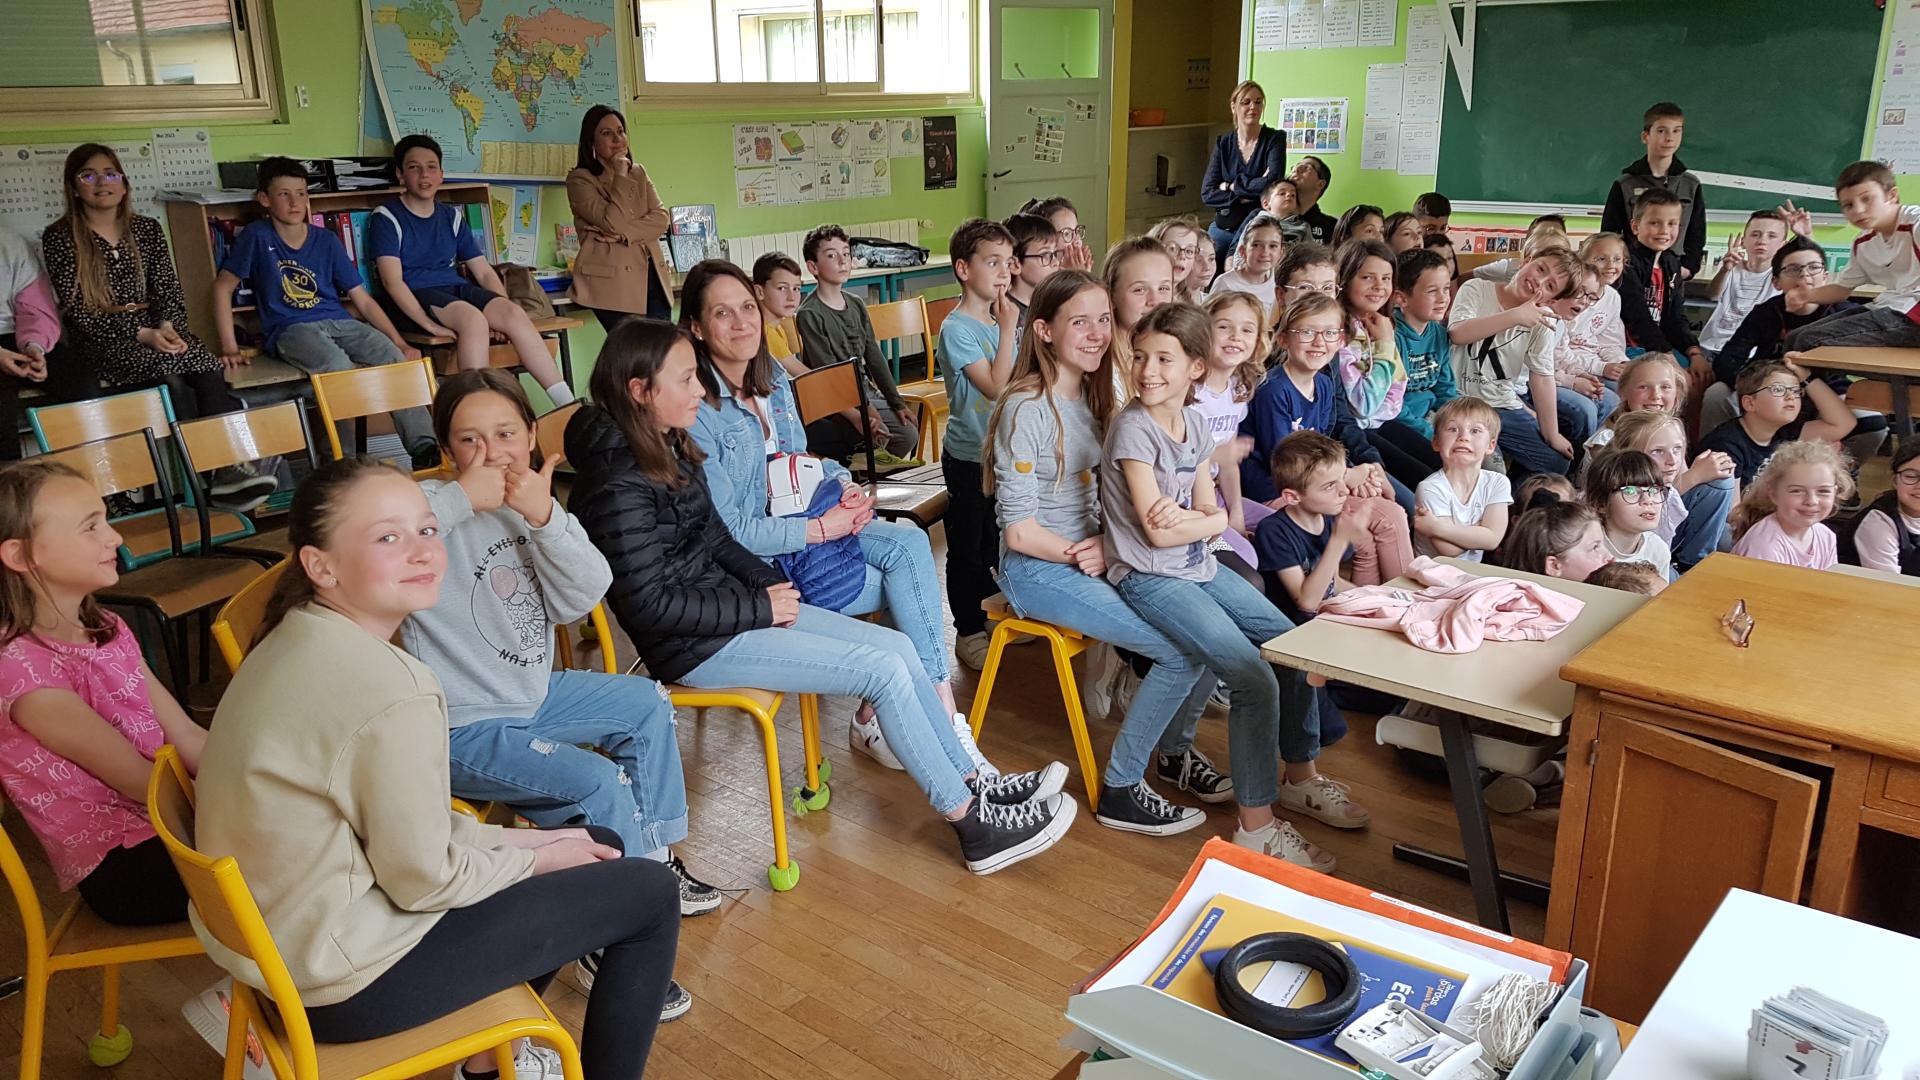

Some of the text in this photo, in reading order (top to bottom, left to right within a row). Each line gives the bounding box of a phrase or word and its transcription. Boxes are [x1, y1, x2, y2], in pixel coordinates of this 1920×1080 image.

[292, 272, 308, 286] 30
[474, 558, 490, 580] ALL
[488, 537, 513, 557] EYES
[499, 648, 528, 667] FUN
[1430, 978, 1450, 1008] bordas
